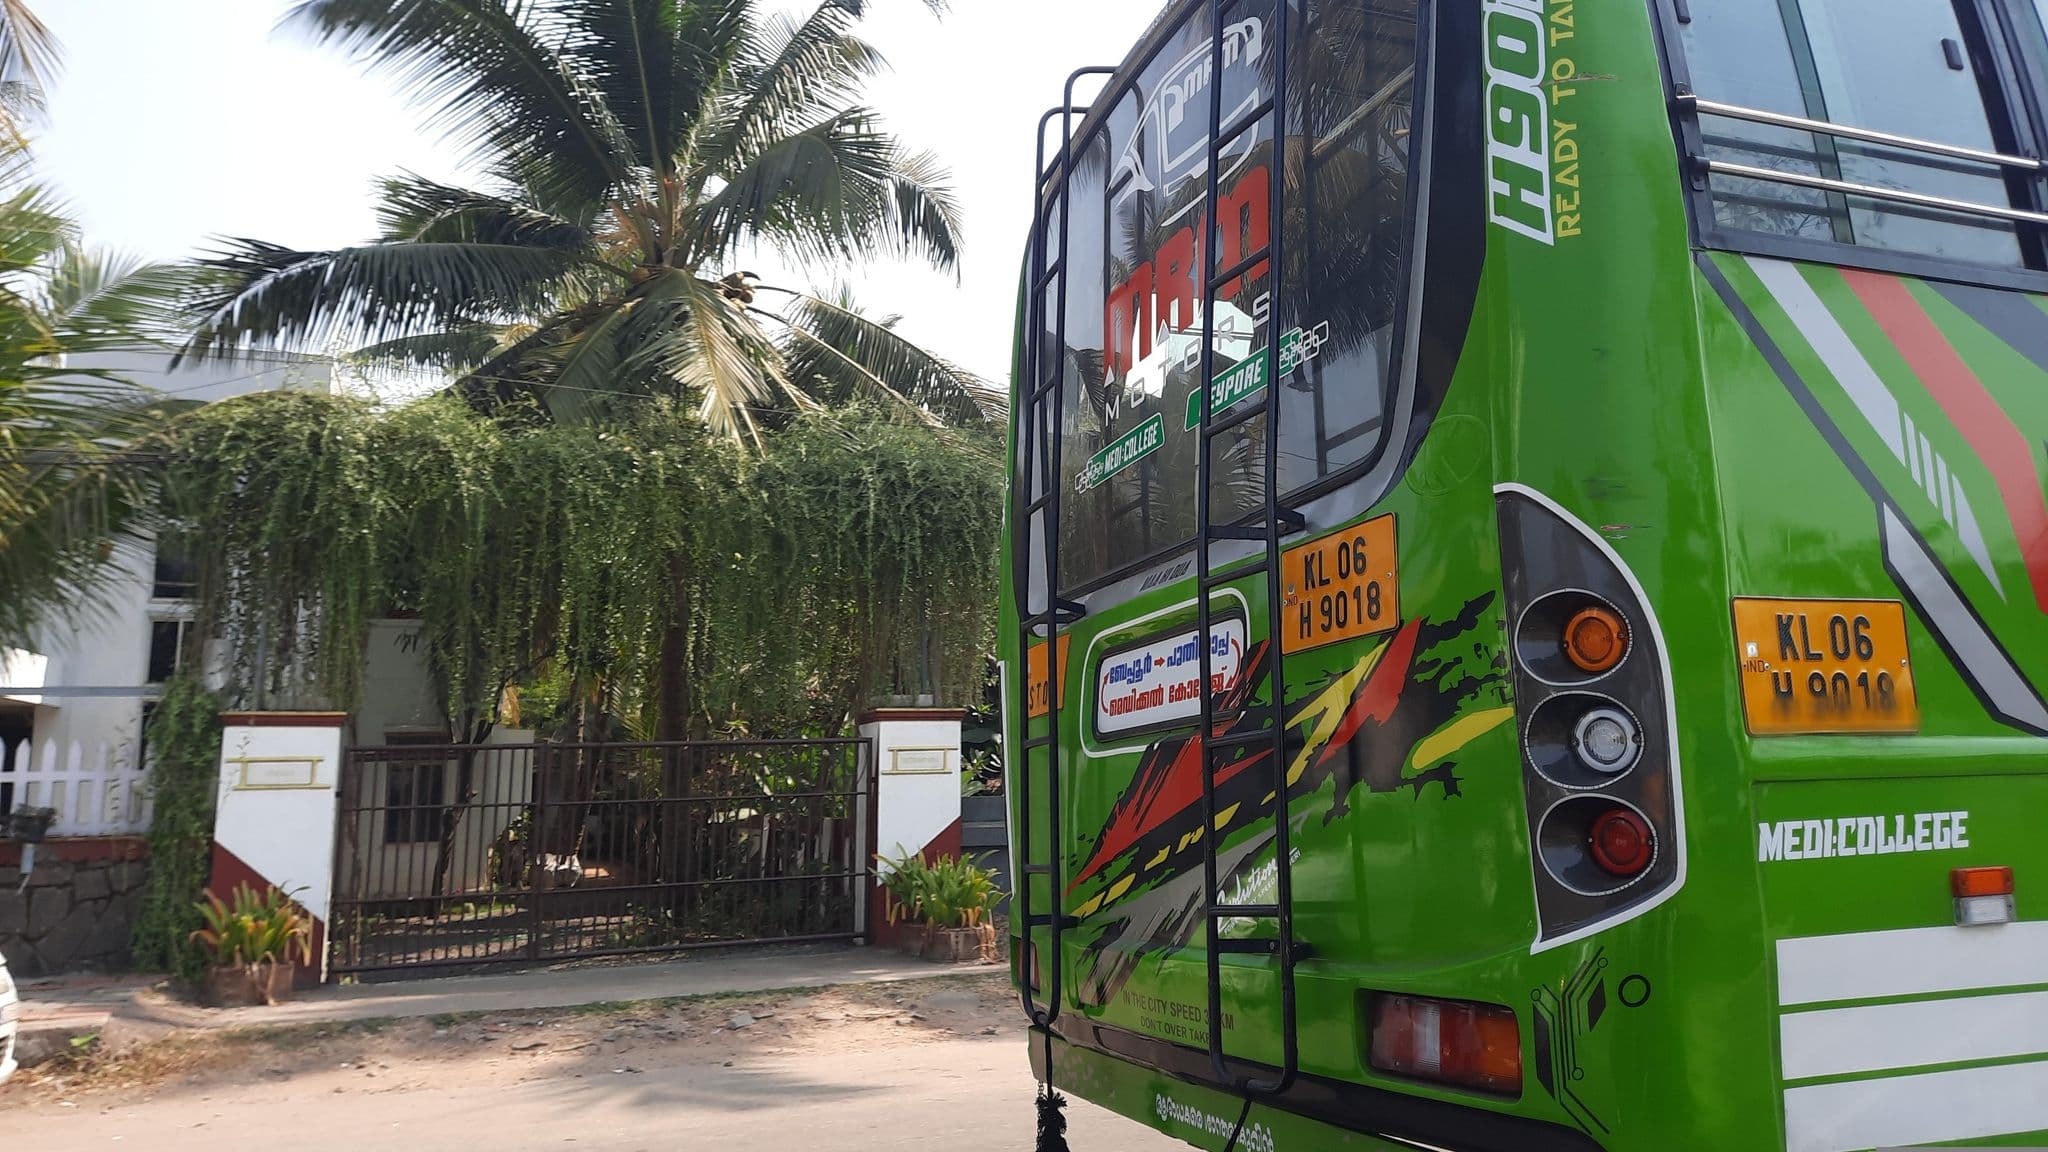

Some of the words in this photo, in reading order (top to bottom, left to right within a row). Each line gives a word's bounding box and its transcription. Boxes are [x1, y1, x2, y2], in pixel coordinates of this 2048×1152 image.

[1549, 0, 1575, 47] TA
[1551, 58, 1577, 105] TO
[1481, 0, 1555, 246] H90
[1553, 119, 1582, 238] READY
[1199, 357, 1264, 417] EYPORE
[1304, 550, 1331, 591] KL
[1337, 536, 1367, 580] 06
[1299, 600, 1312, 639] H
[1320, 580, 1381, 633] 9018
[1775, 613, 1823, 662] KL
[1828, 614, 1874, 662] 06
[1746, 659, 1766, 673] IND
[1029, 681, 1049, 710] STO
[1132, 991, 1147, 1010] THE
[1147, 997, 1168, 1015] CITY
[1169, 1001, 1202, 1023] SPEED
[1164, 1022, 1188, 1039] OVER
